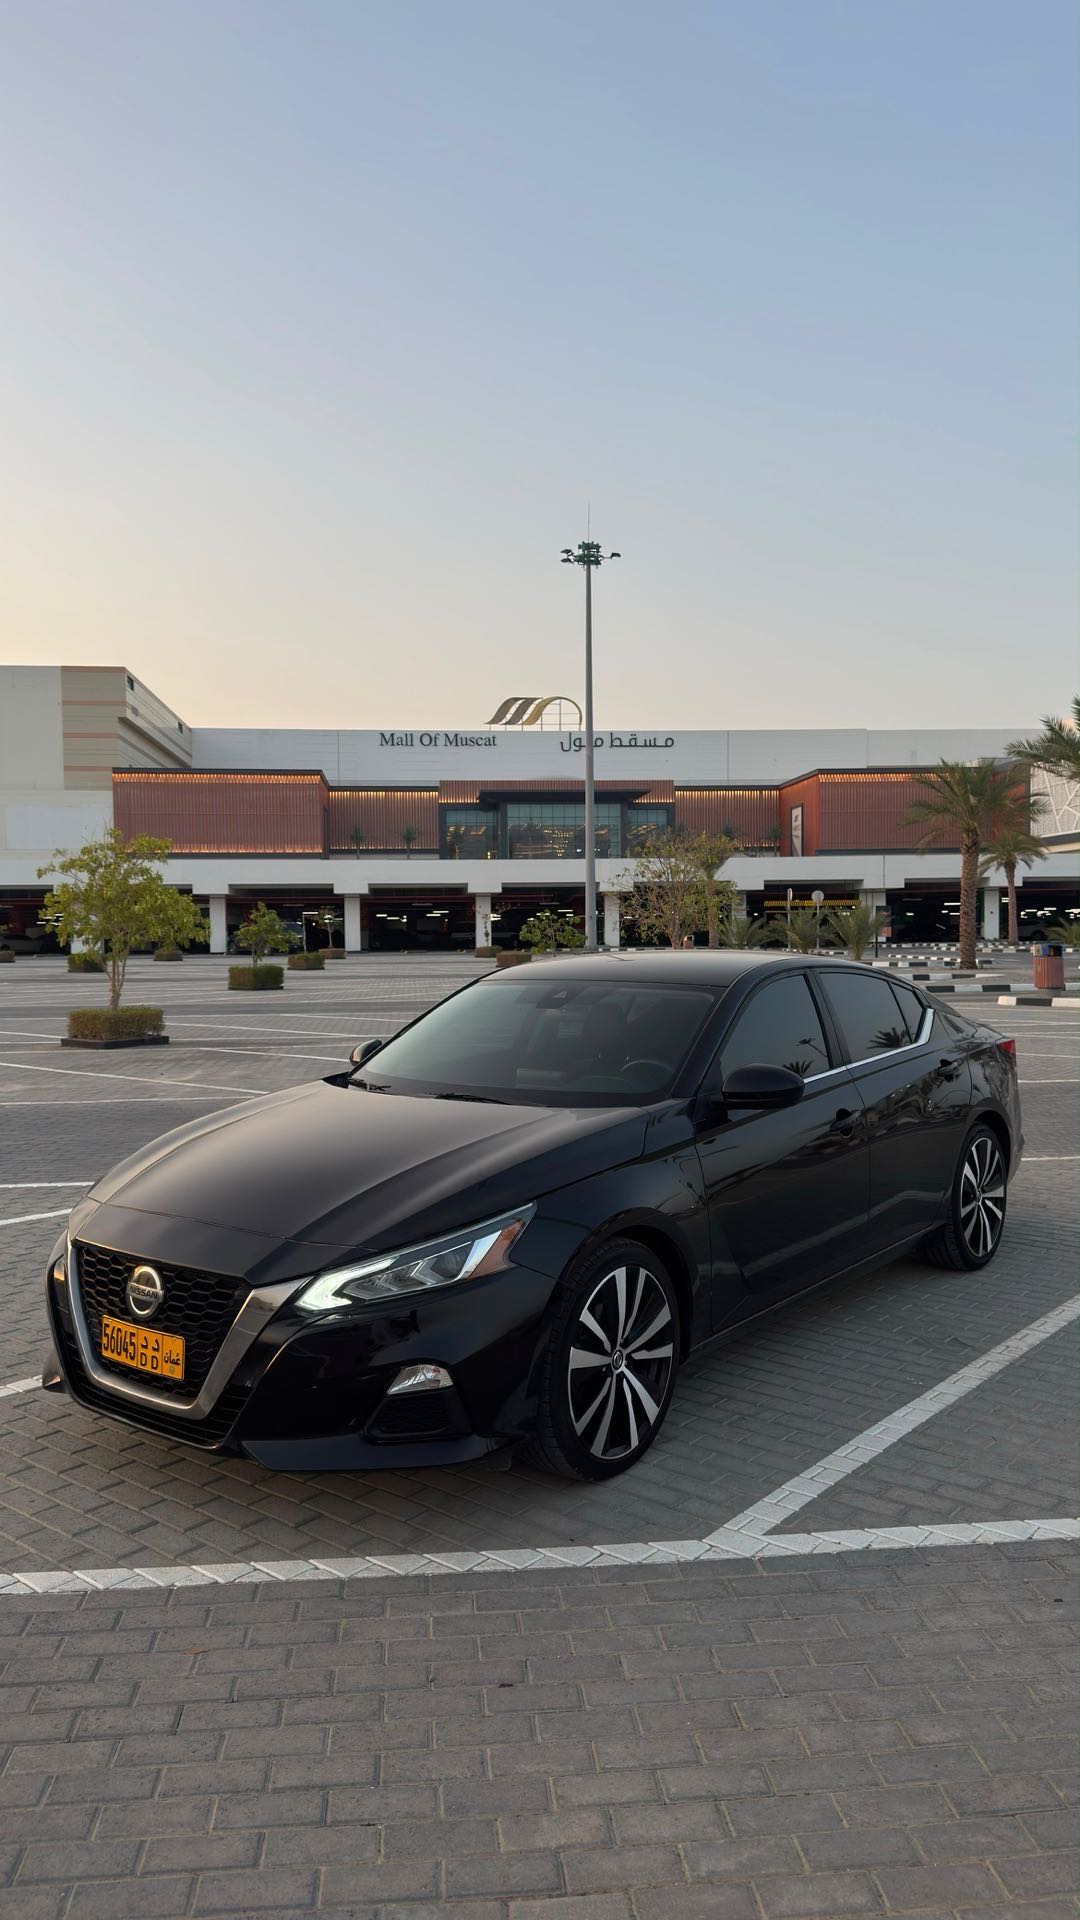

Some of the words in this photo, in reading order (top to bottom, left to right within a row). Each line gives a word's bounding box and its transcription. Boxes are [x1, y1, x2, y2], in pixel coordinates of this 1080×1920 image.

[379, 732, 414, 747] Mall
[419, 732, 440, 747] Of
[443, 732, 497, 747] Muscat
[560, 732, 604, 752] مول
[609, 732, 675, 748] مسقط
[129, 1286, 158, 1299] NISSAN
[103, 1323, 136, 1360] 56045
